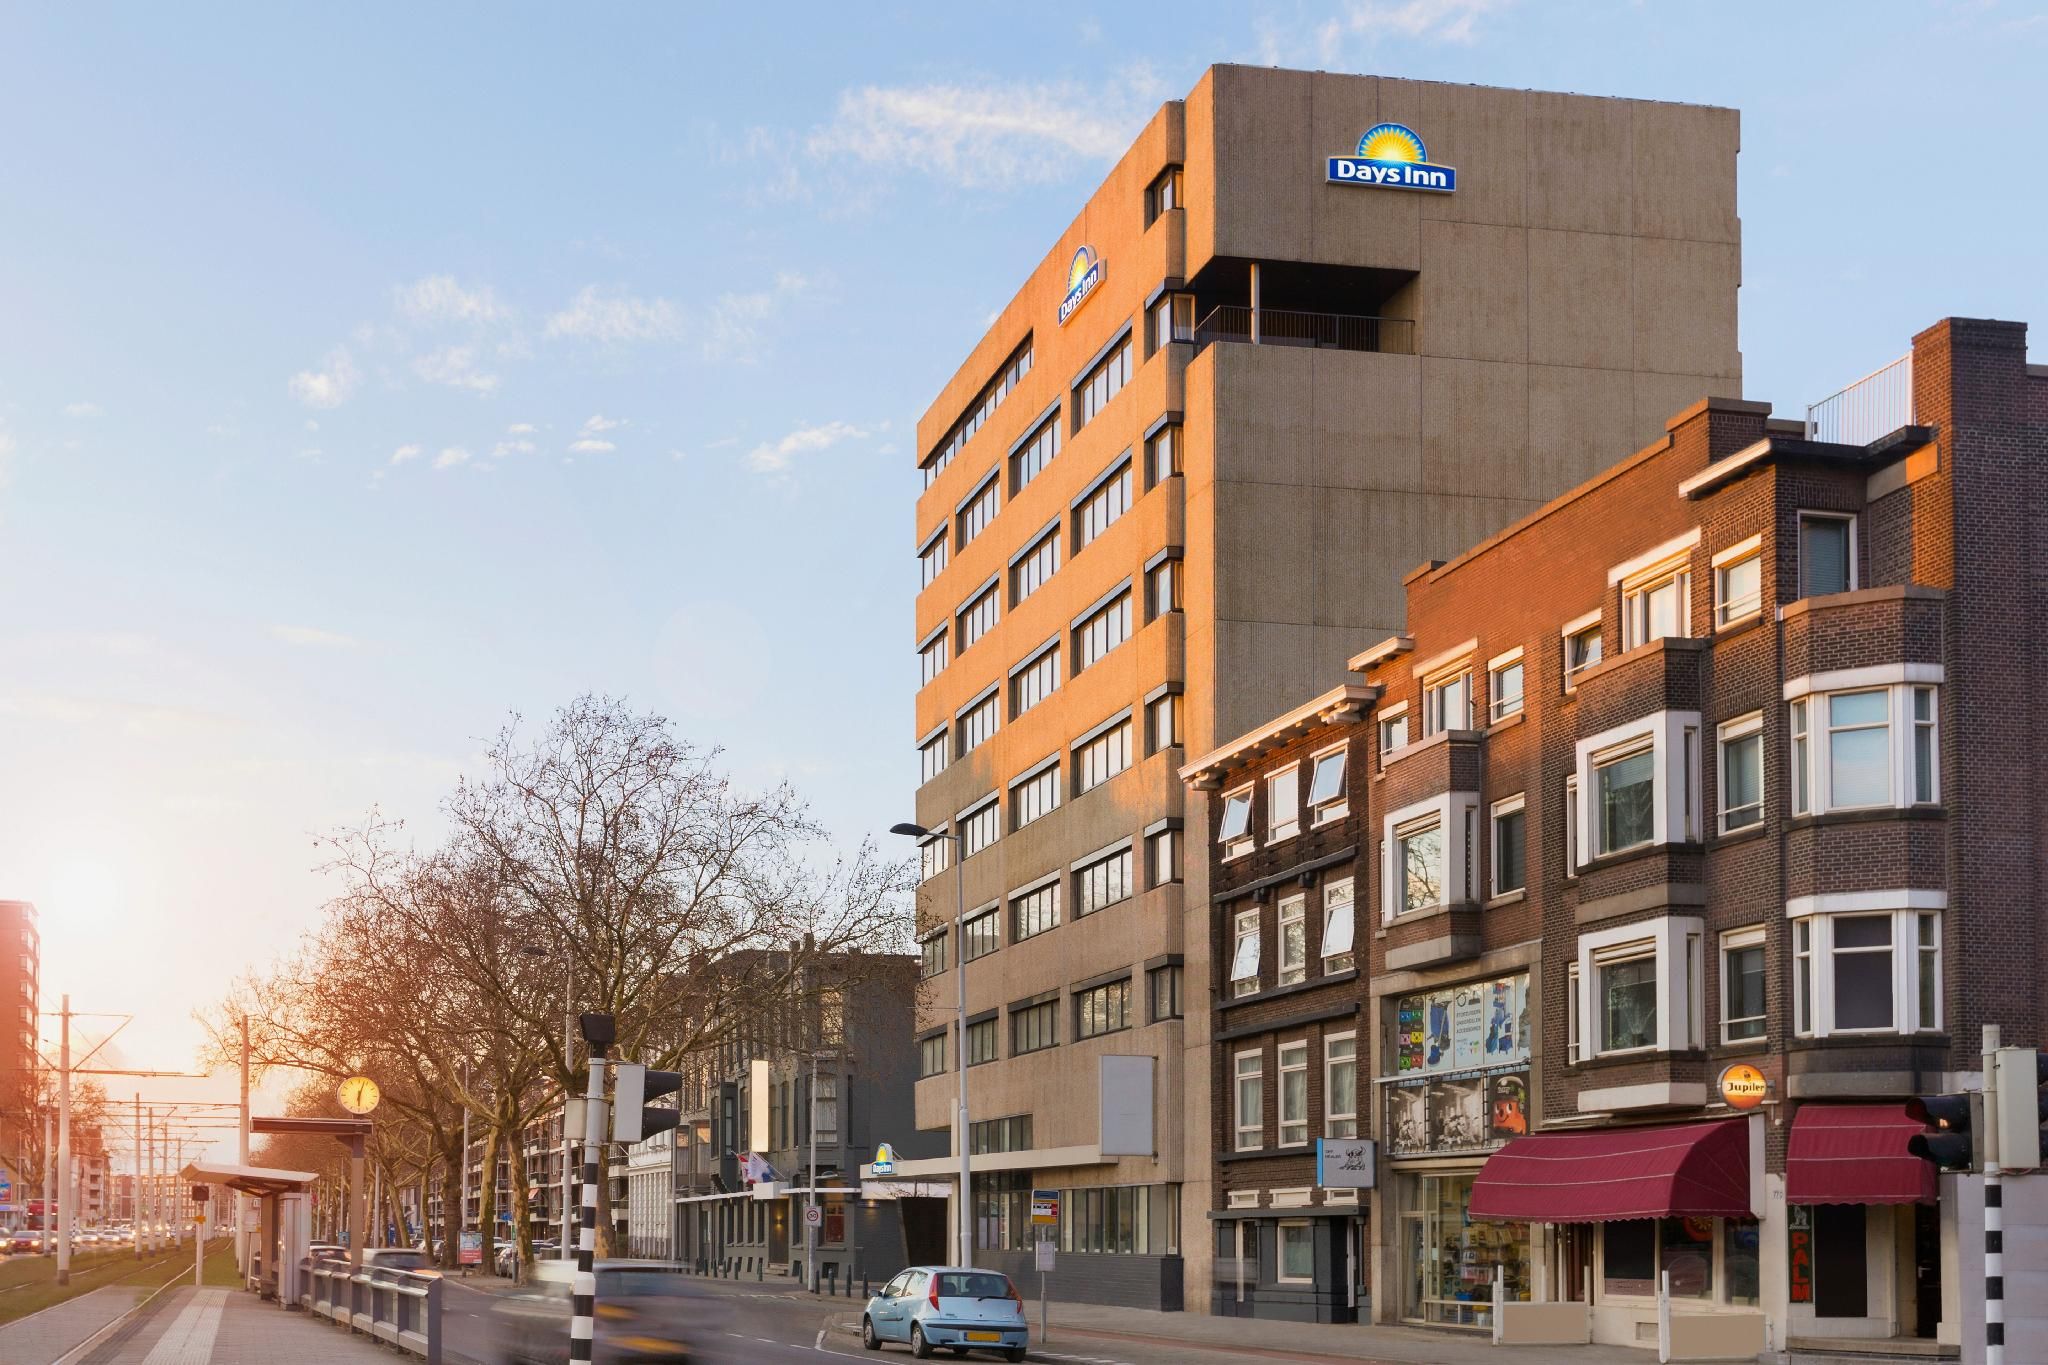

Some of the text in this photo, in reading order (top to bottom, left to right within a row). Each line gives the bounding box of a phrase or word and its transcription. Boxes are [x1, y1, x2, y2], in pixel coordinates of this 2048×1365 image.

[1337, 160, 1447, 187] Days Inn
[1060, 270, 1097, 321] Days Inn
[1727, 1082, 1765, 1093] Jupiler
[872, 1164, 884, 1173] Days
[1791, 1231, 1809, 1300] PALM
